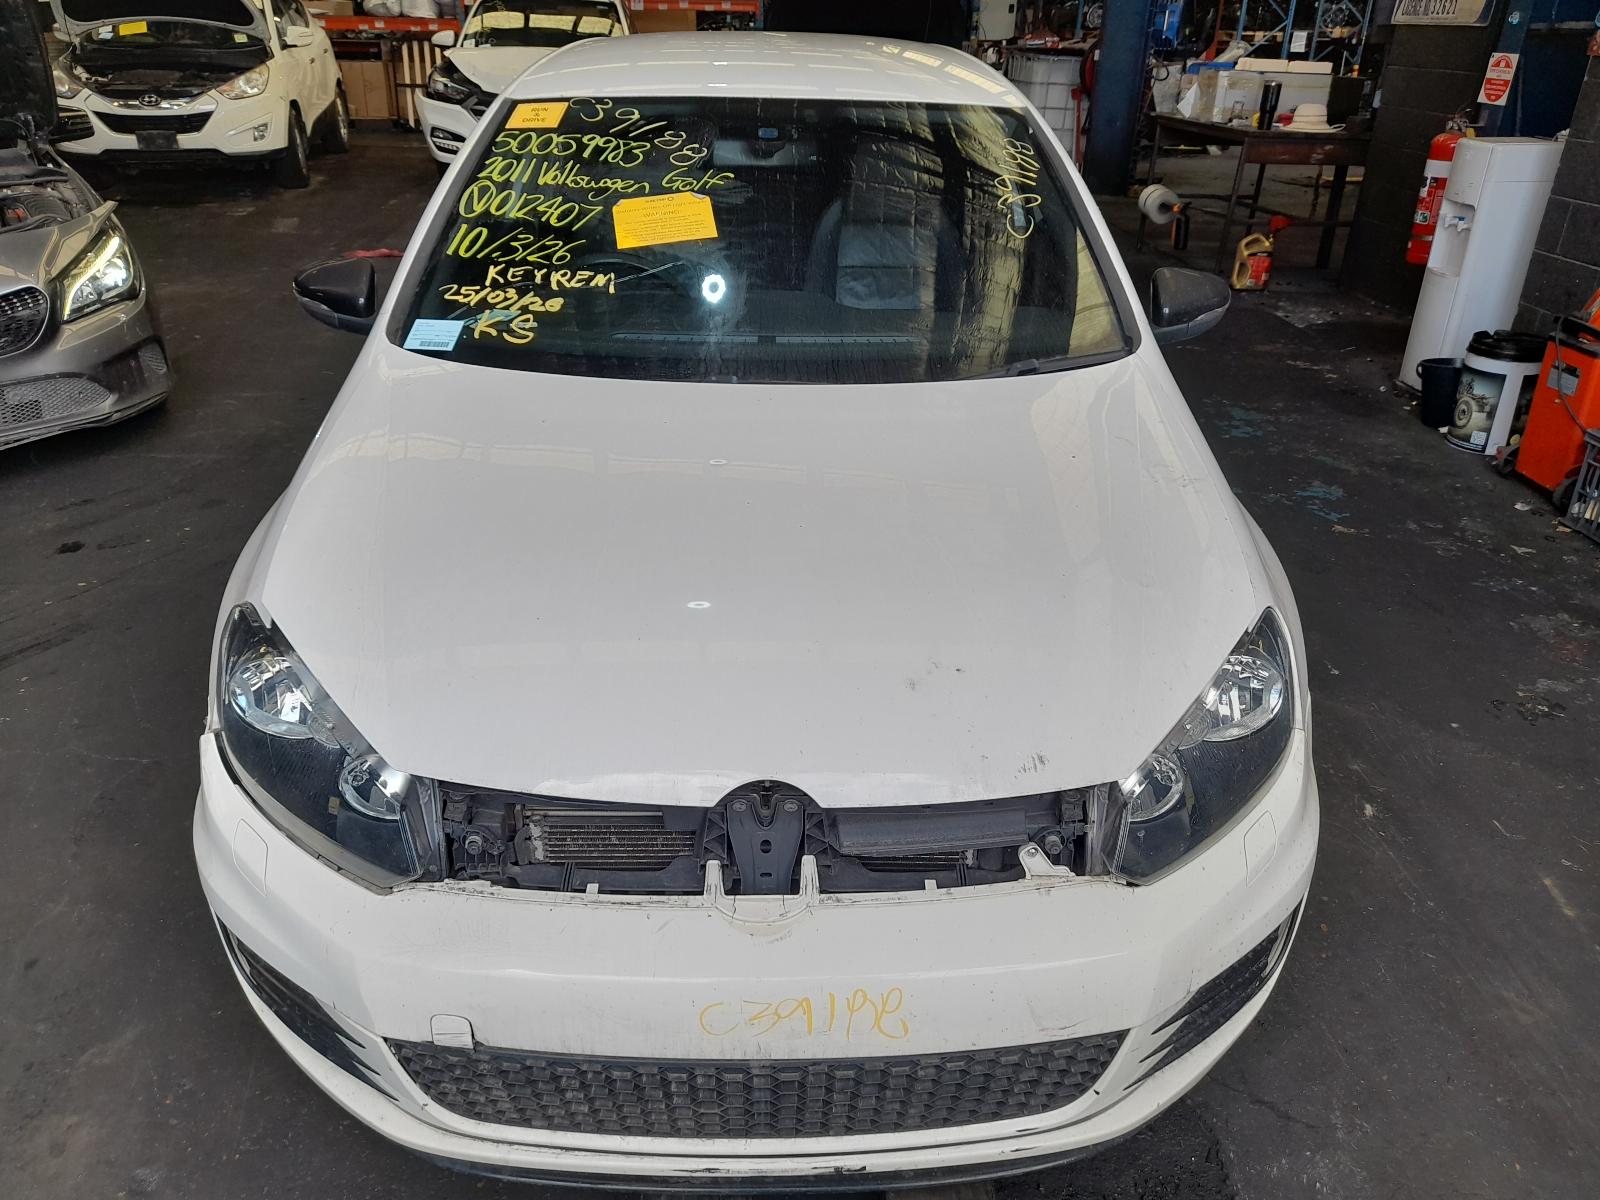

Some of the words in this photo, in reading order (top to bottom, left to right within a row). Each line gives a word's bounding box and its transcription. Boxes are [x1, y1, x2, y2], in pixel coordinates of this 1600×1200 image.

[492, 131, 651, 168] 50059983
[477, 156, 537, 184] 2011
[661, 167, 735, 191] Golf
